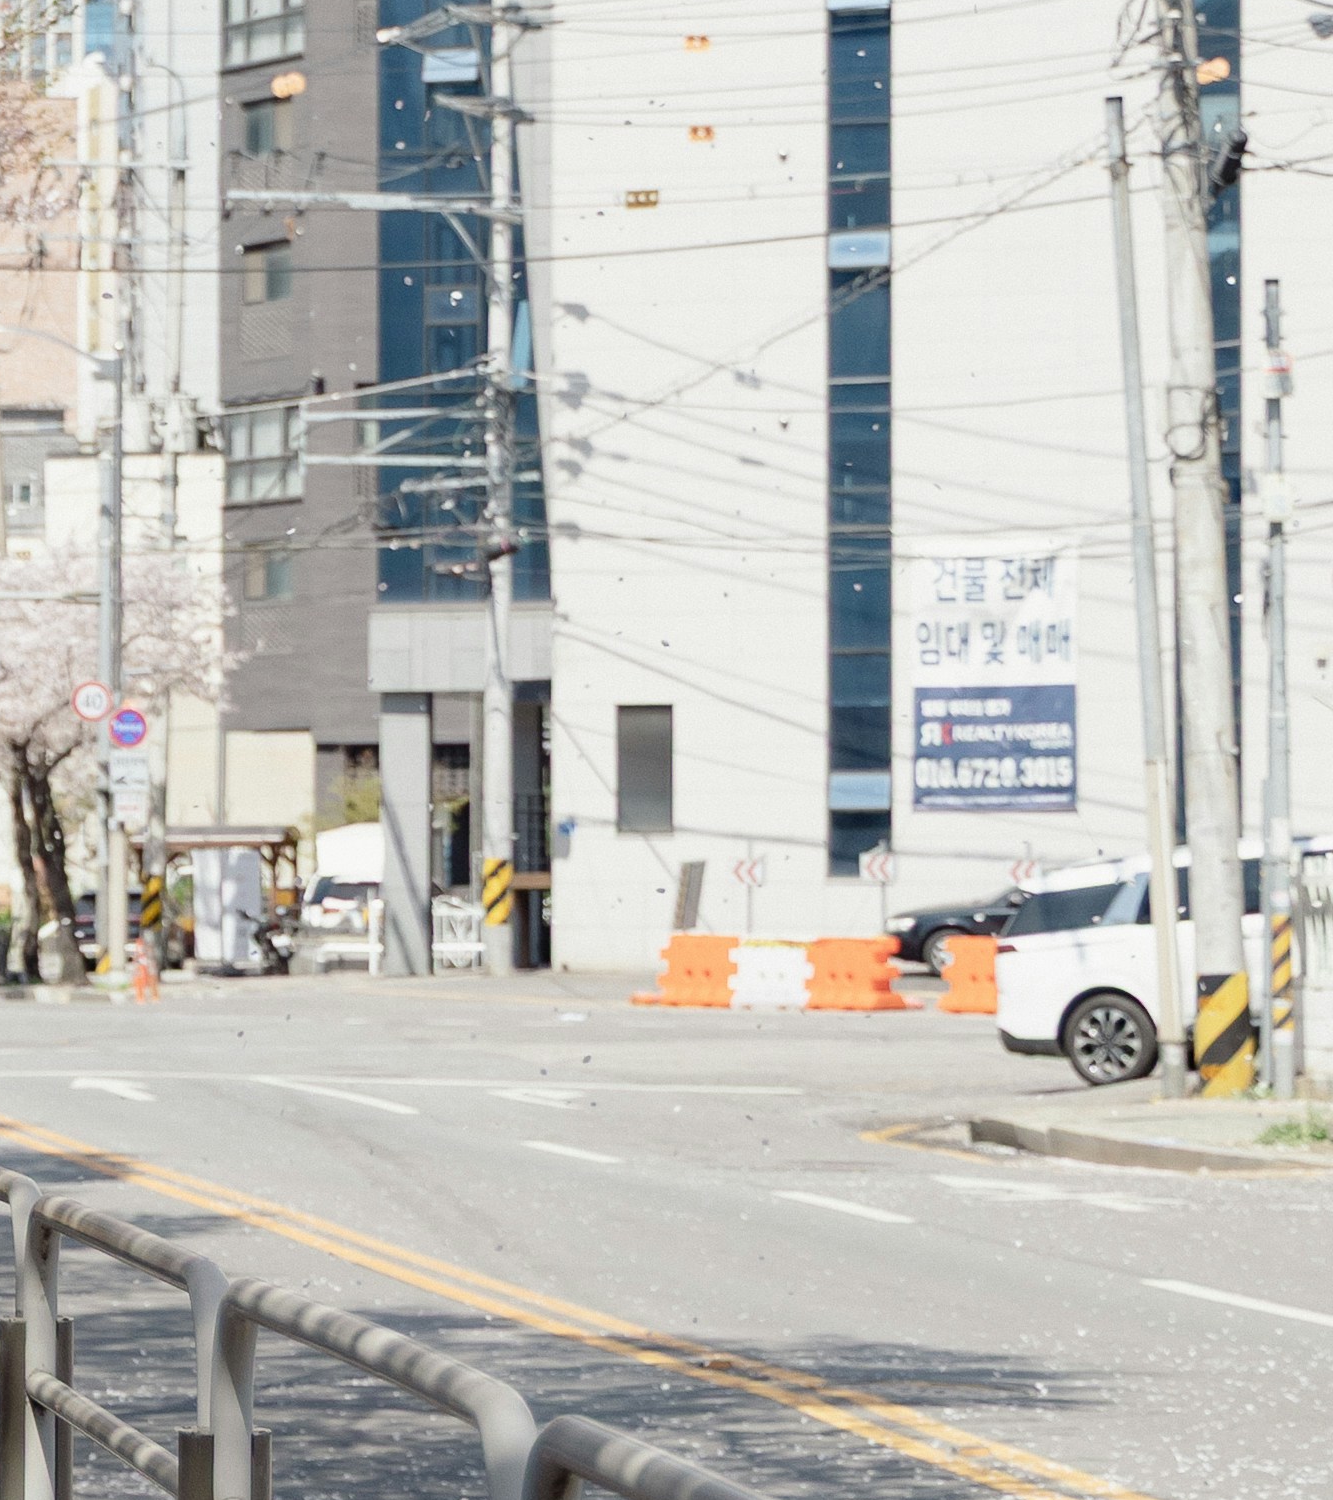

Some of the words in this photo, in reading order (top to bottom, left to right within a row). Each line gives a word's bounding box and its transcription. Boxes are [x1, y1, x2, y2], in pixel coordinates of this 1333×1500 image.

[933, 557, 987, 602] 건물
[1000, 557, 1054, 601] 전체
[916, 621, 969, 666] 임대
[981, 620, 1007, 665] 및
[1017, 618, 1071, 664] 매매
